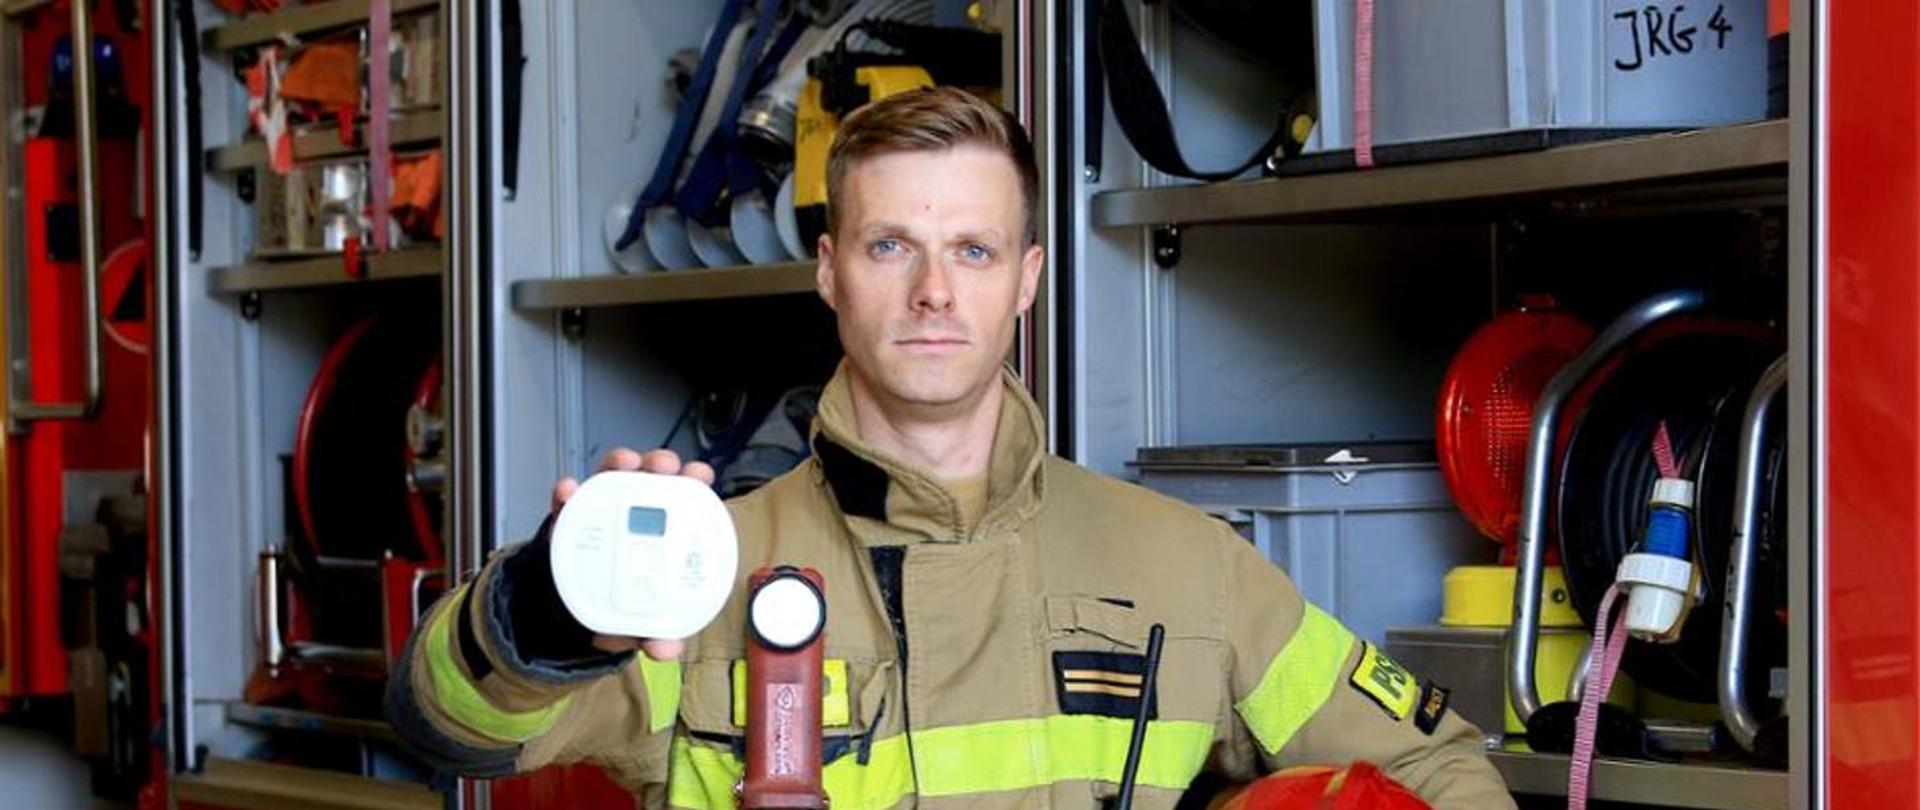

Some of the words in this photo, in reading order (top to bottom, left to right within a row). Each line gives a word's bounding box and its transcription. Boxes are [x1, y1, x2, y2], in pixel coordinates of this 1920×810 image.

[1613, 5, 1697, 71] JRG
[1707, 4, 1733, 49] 4
[1370, 653, 1407, 700] PS
